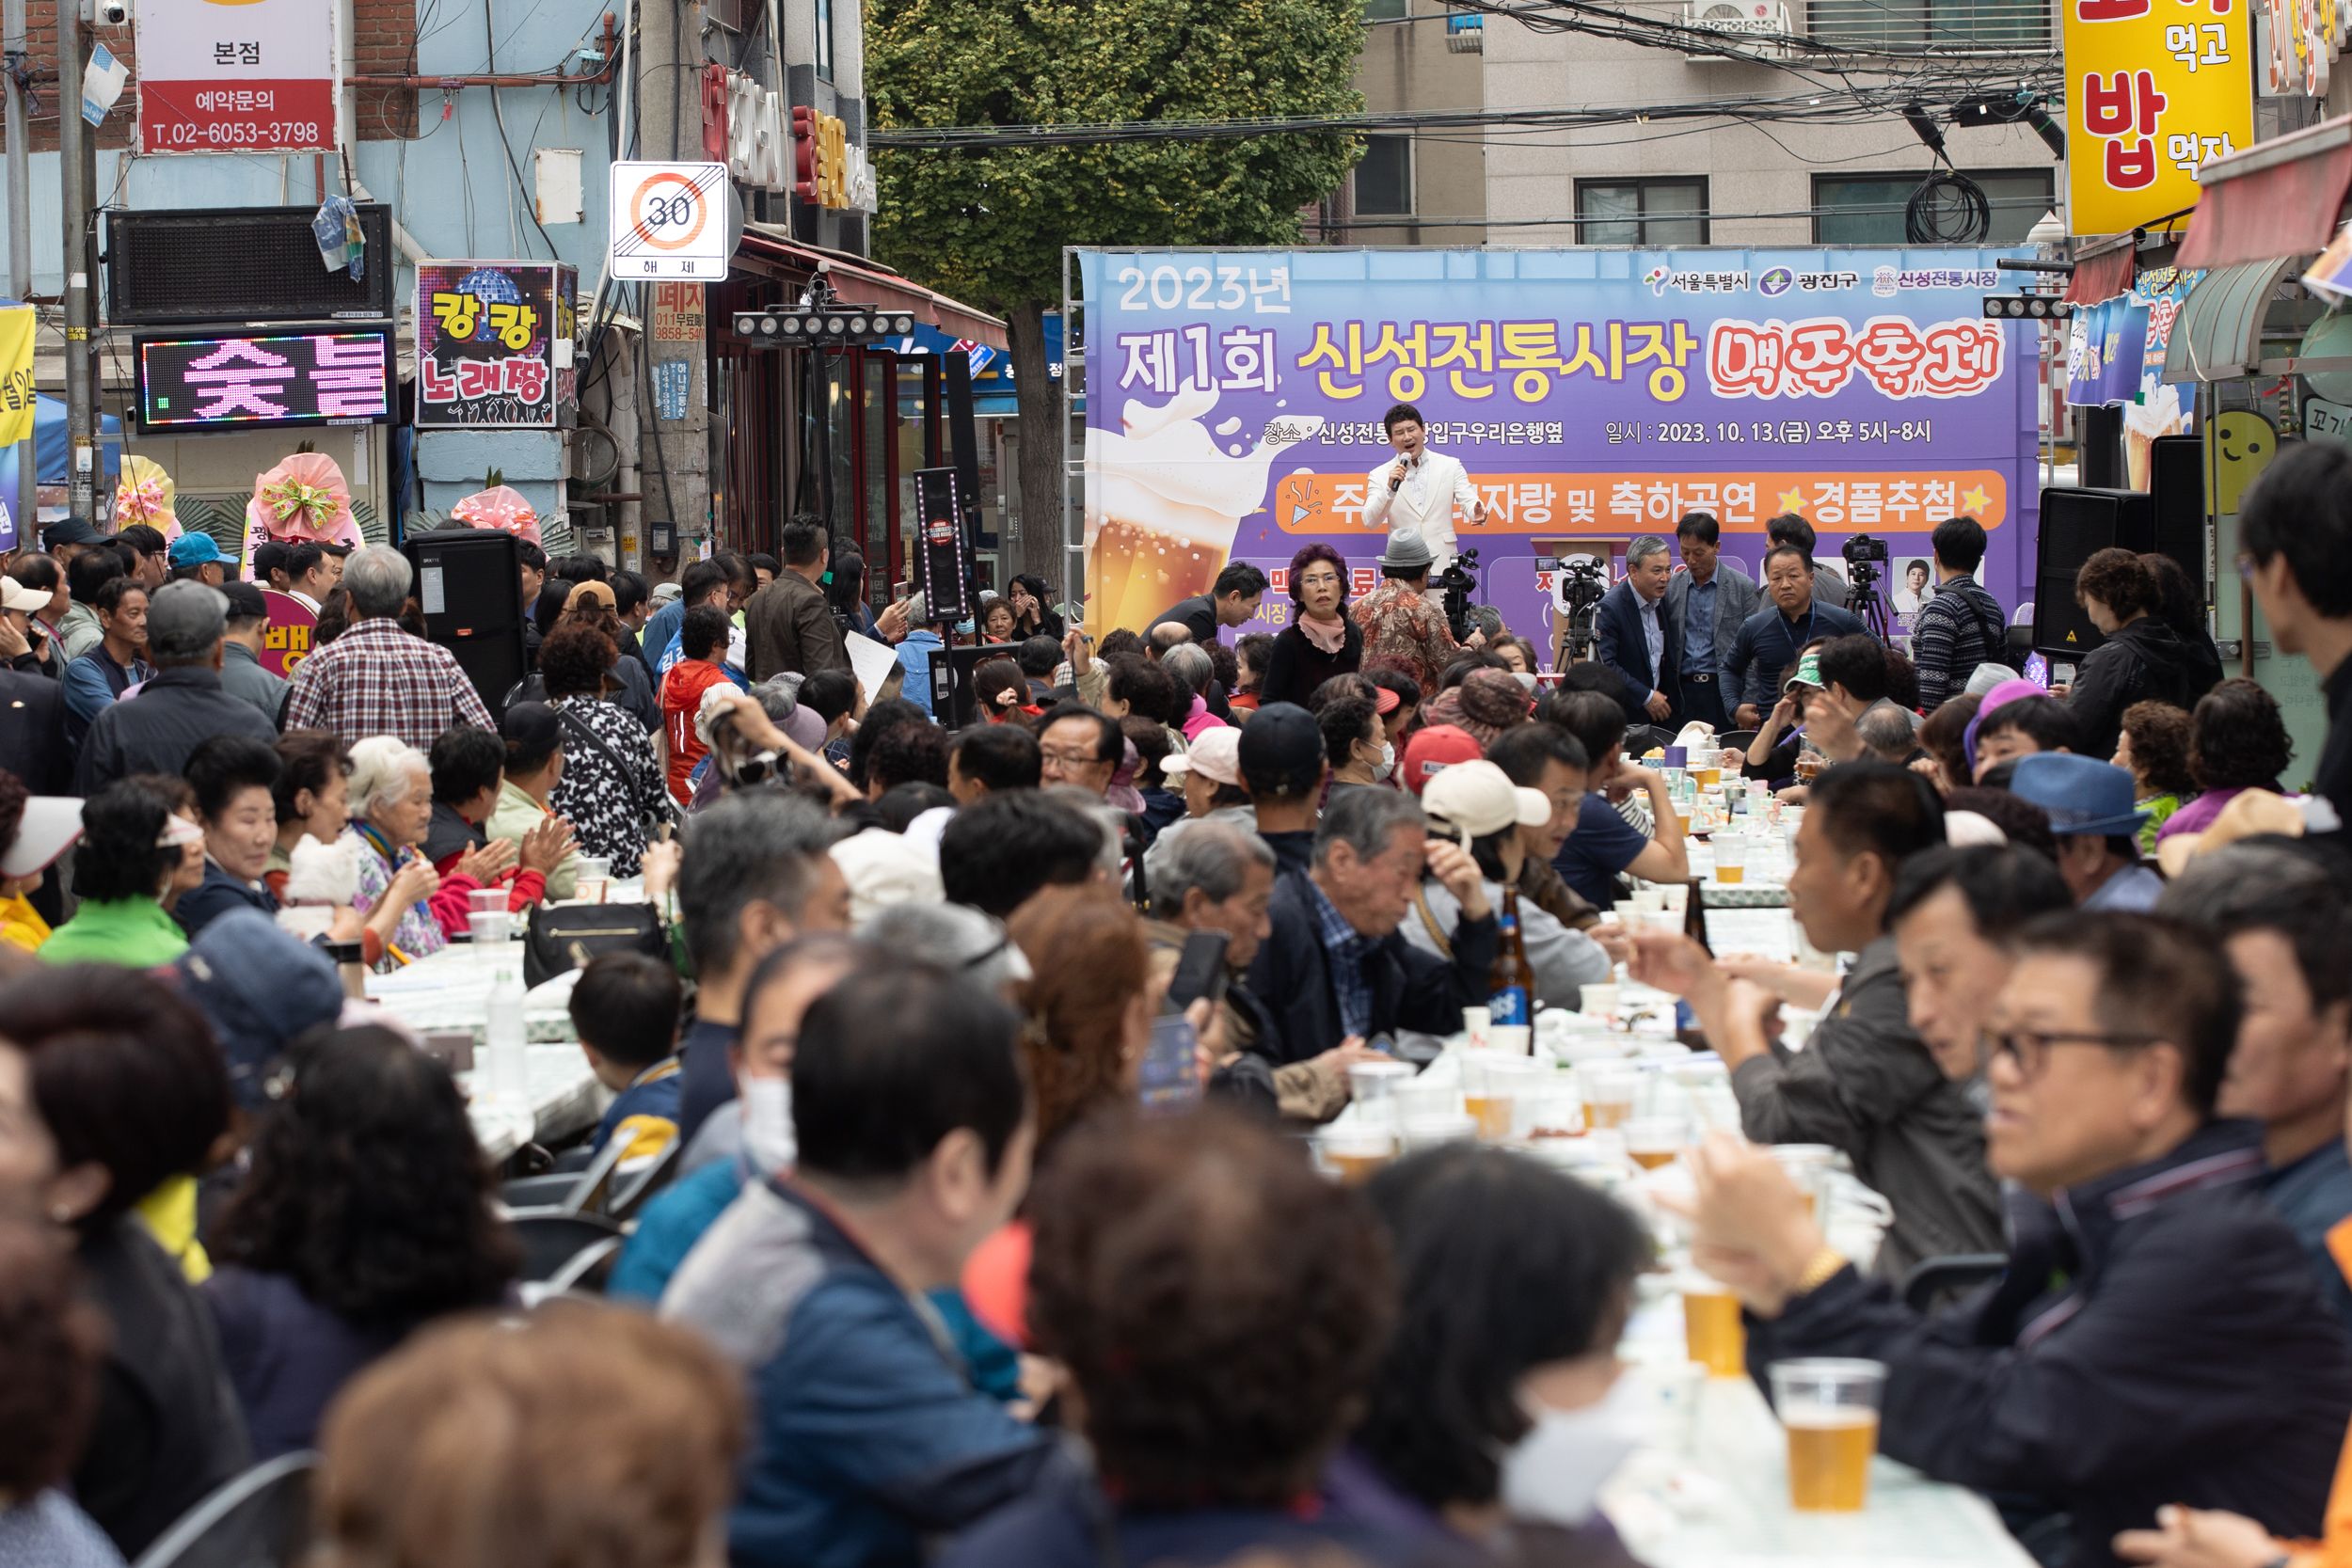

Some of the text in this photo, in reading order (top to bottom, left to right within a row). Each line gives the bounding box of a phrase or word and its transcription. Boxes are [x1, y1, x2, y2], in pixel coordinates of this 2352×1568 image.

[214, 41, 261, 65] 본점
[2166, 23, 2231, 73] 먹고
[196, 90, 275, 112] 예약문의
[152, 121, 319, 145] T.02-6053-3798
[2083, 69, 2235, 191] 밥 먹자
[648, 197, 690, 226] 30
[1118, 265, 1292, 314] 2023년
[1671, 270, 1750, 293] 서울특별시
[1798, 272, 1860, 291] 광진구
[1898, 271, 1998, 288] 신성전통시장
[656, 313, 675, 325] 011
[1118, 325, 1279, 394] 제1회
[1297, 319, 1698, 403] 신성전통시장
[1708, 316, 2005, 400] 맥주축제
[422, 356, 549, 404] 노래짱
[1263, 422, 1302, 445] 장소
[1605, 420, 1642, 444] 일시
[1657, 422, 1710, 444] 2023.
[1717, 422, 1745, 444] 10.
[1750, 420, 1812, 445] 13.(금)
[1816, 420, 1854, 443] 오후
[1858, 420, 1931, 444] 5시~8시
[1568, 489, 1596, 523] 및
[1609, 482, 1757, 523] 축하공연
[1813, 481, 1956, 523] 경품추첨
